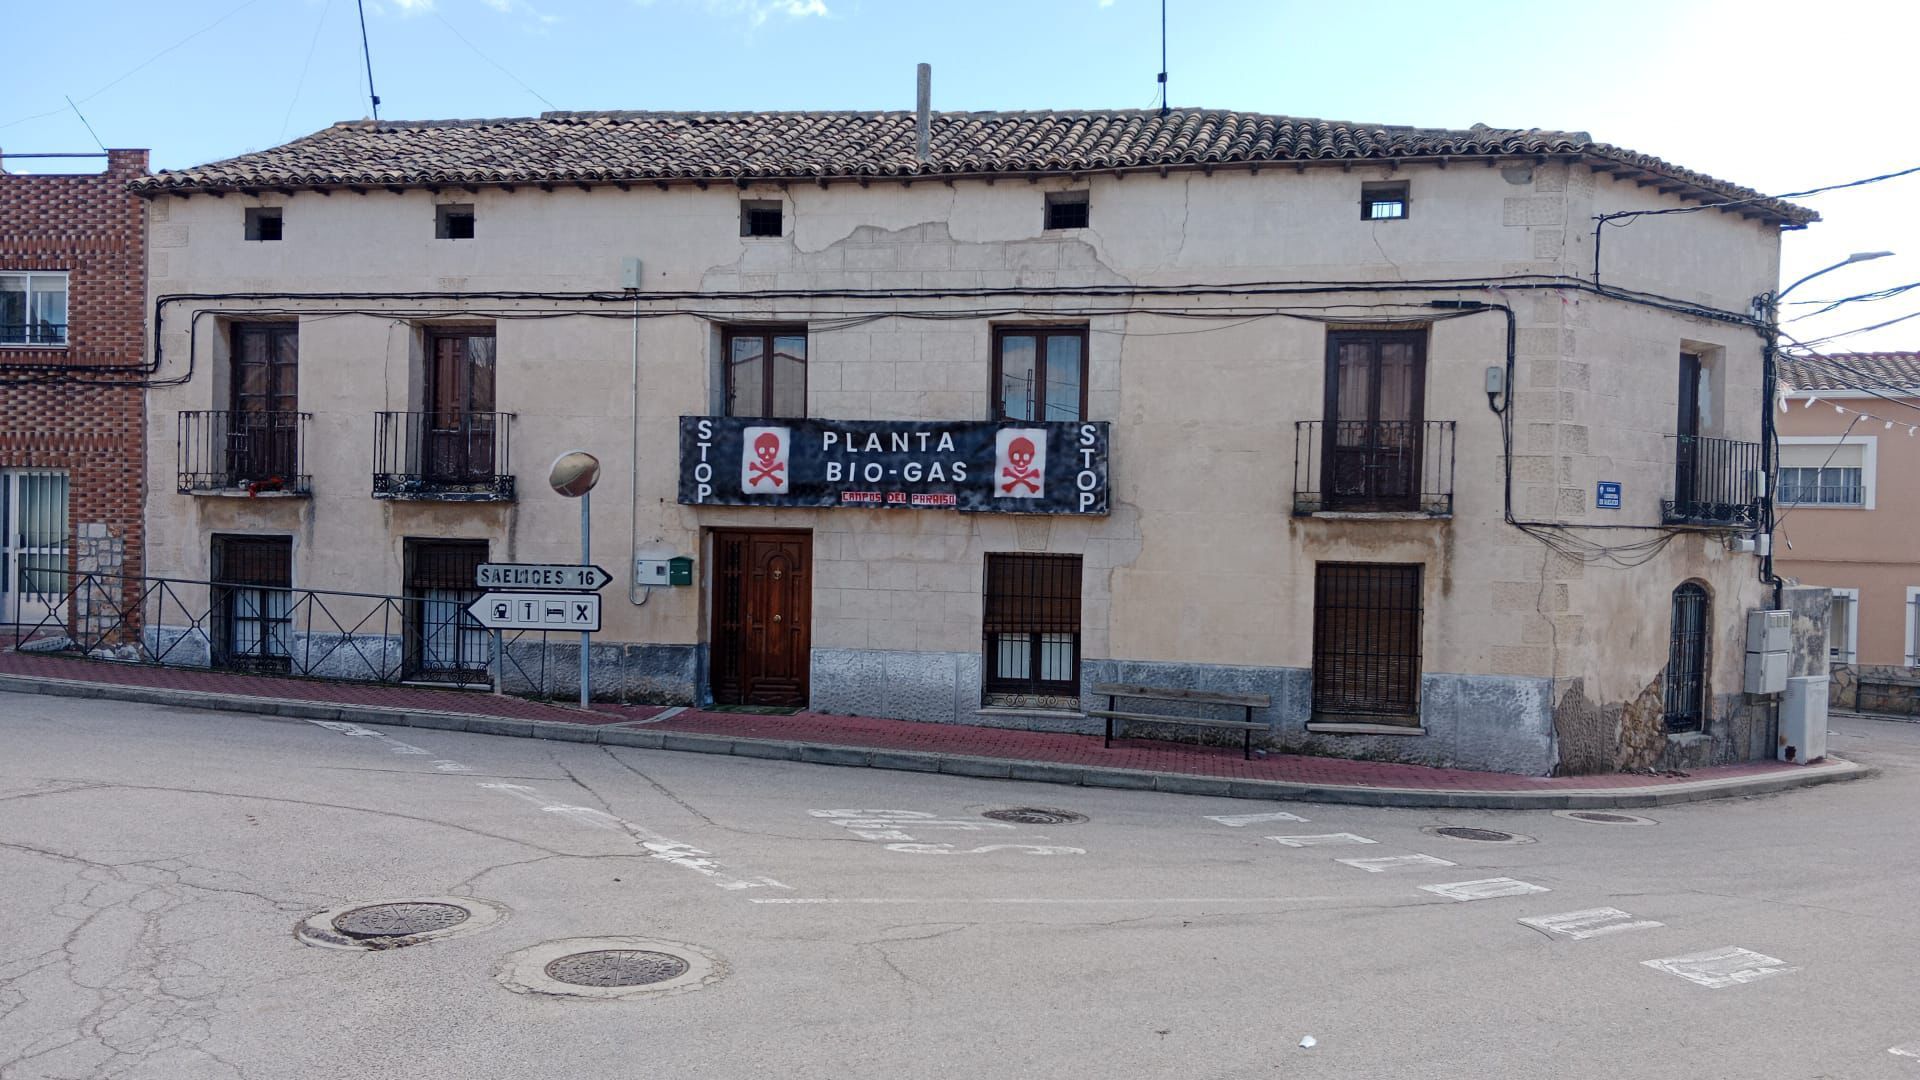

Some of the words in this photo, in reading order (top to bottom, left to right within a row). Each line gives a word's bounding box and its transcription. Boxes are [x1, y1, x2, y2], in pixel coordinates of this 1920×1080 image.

[823, 431, 955, 452] PLANTA
[694, 420, 713, 504] STOP
[826, 461, 967, 482] BIO-GAS
[1076, 424, 1097, 513] STOP
[842, 491, 882, 502] CAMPOS
[887, 492, 906, 503] DEL
[912, 494, 956, 505] PARAISO
[577, 571, 595, 586] 16
